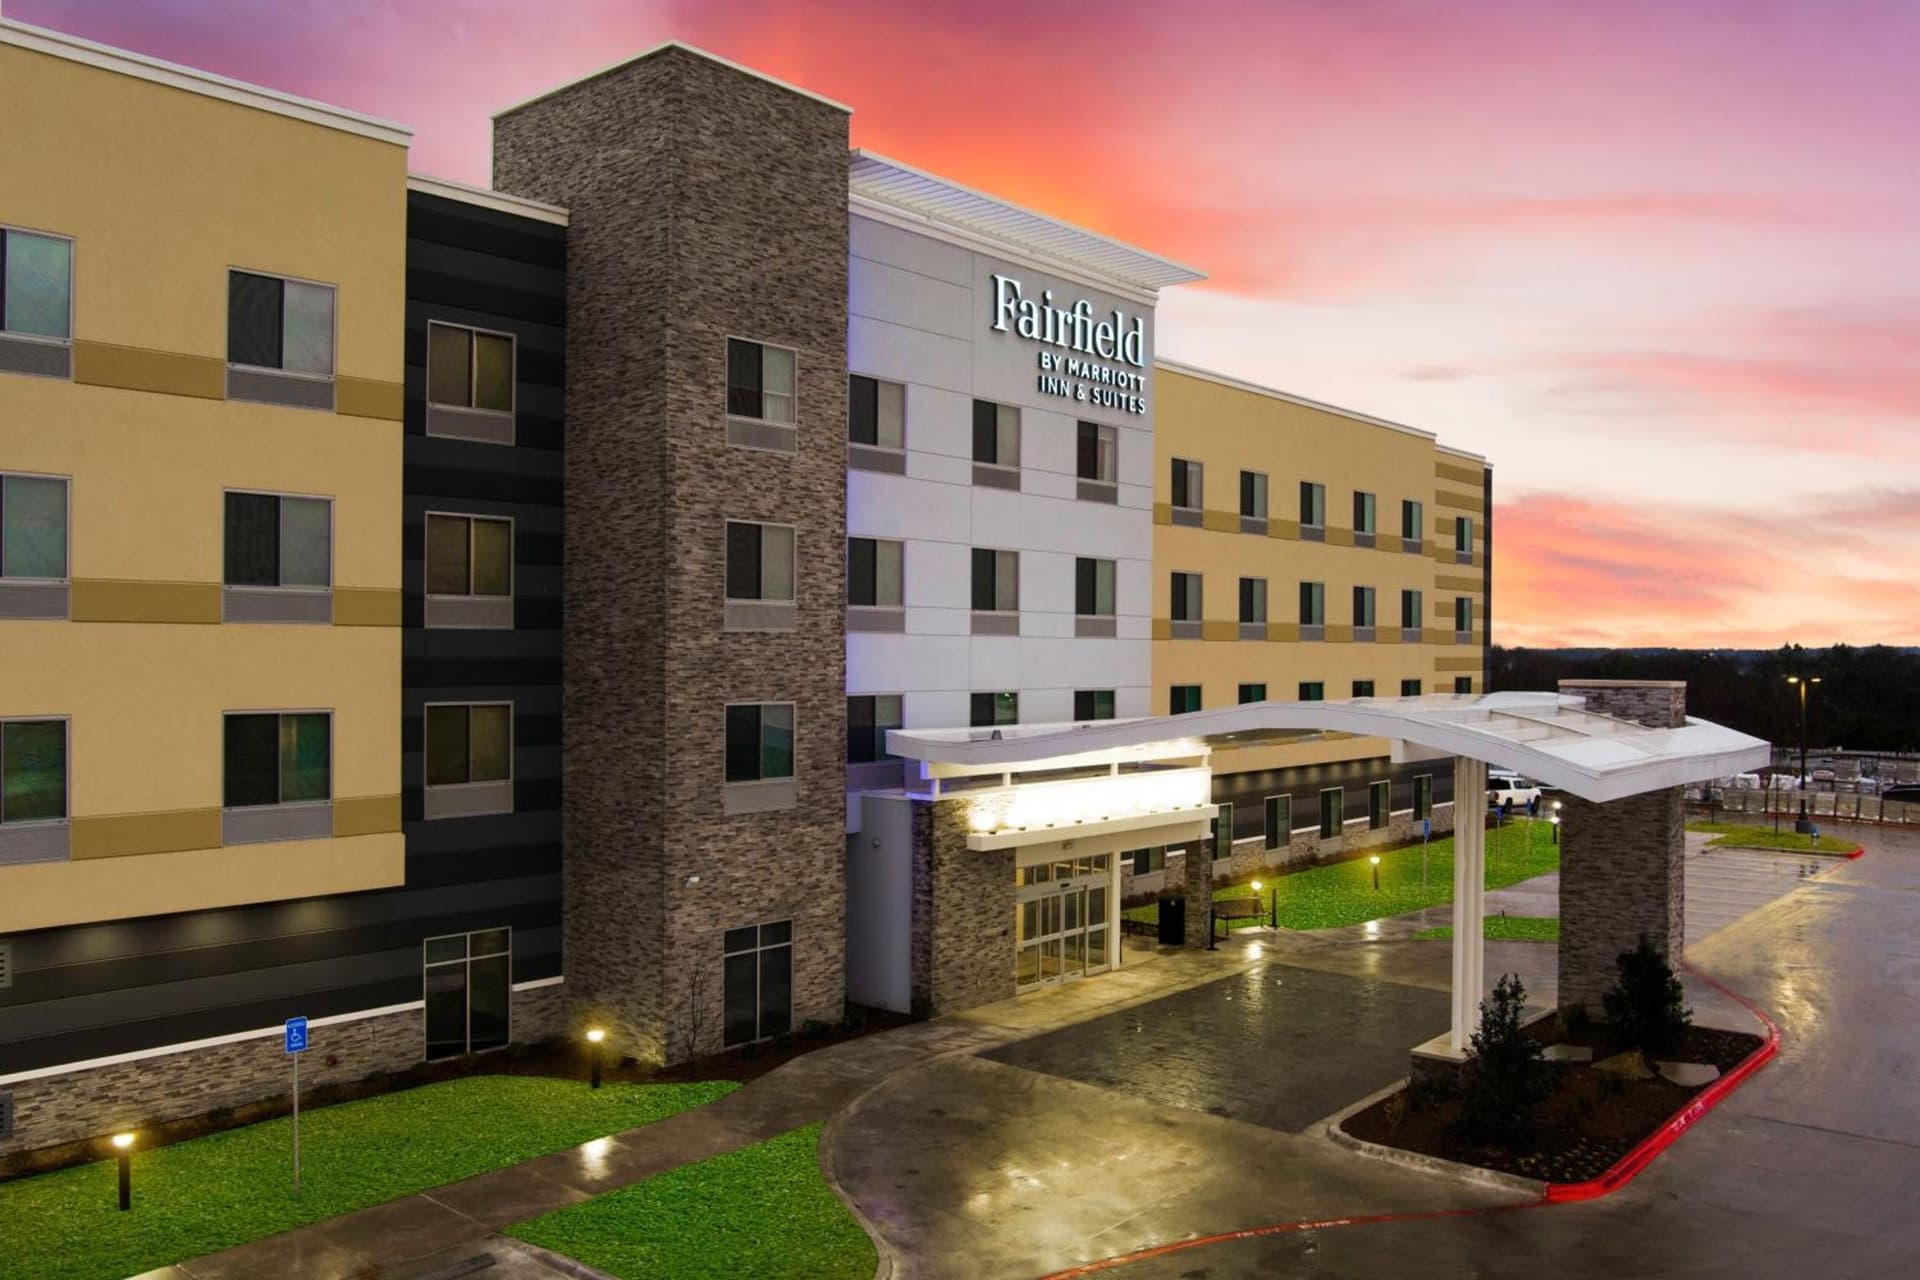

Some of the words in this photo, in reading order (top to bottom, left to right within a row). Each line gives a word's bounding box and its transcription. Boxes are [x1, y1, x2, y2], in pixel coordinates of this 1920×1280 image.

[992, 274, 1145, 367] Fairfield
[1040, 351, 1062, 371] BY
[1067, 358, 1146, 393] MARRIOTT
[1040, 375, 1070, 397] INN
[1075, 383, 1086, 401] &
[1091, 386, 1145, 414] SUITES
